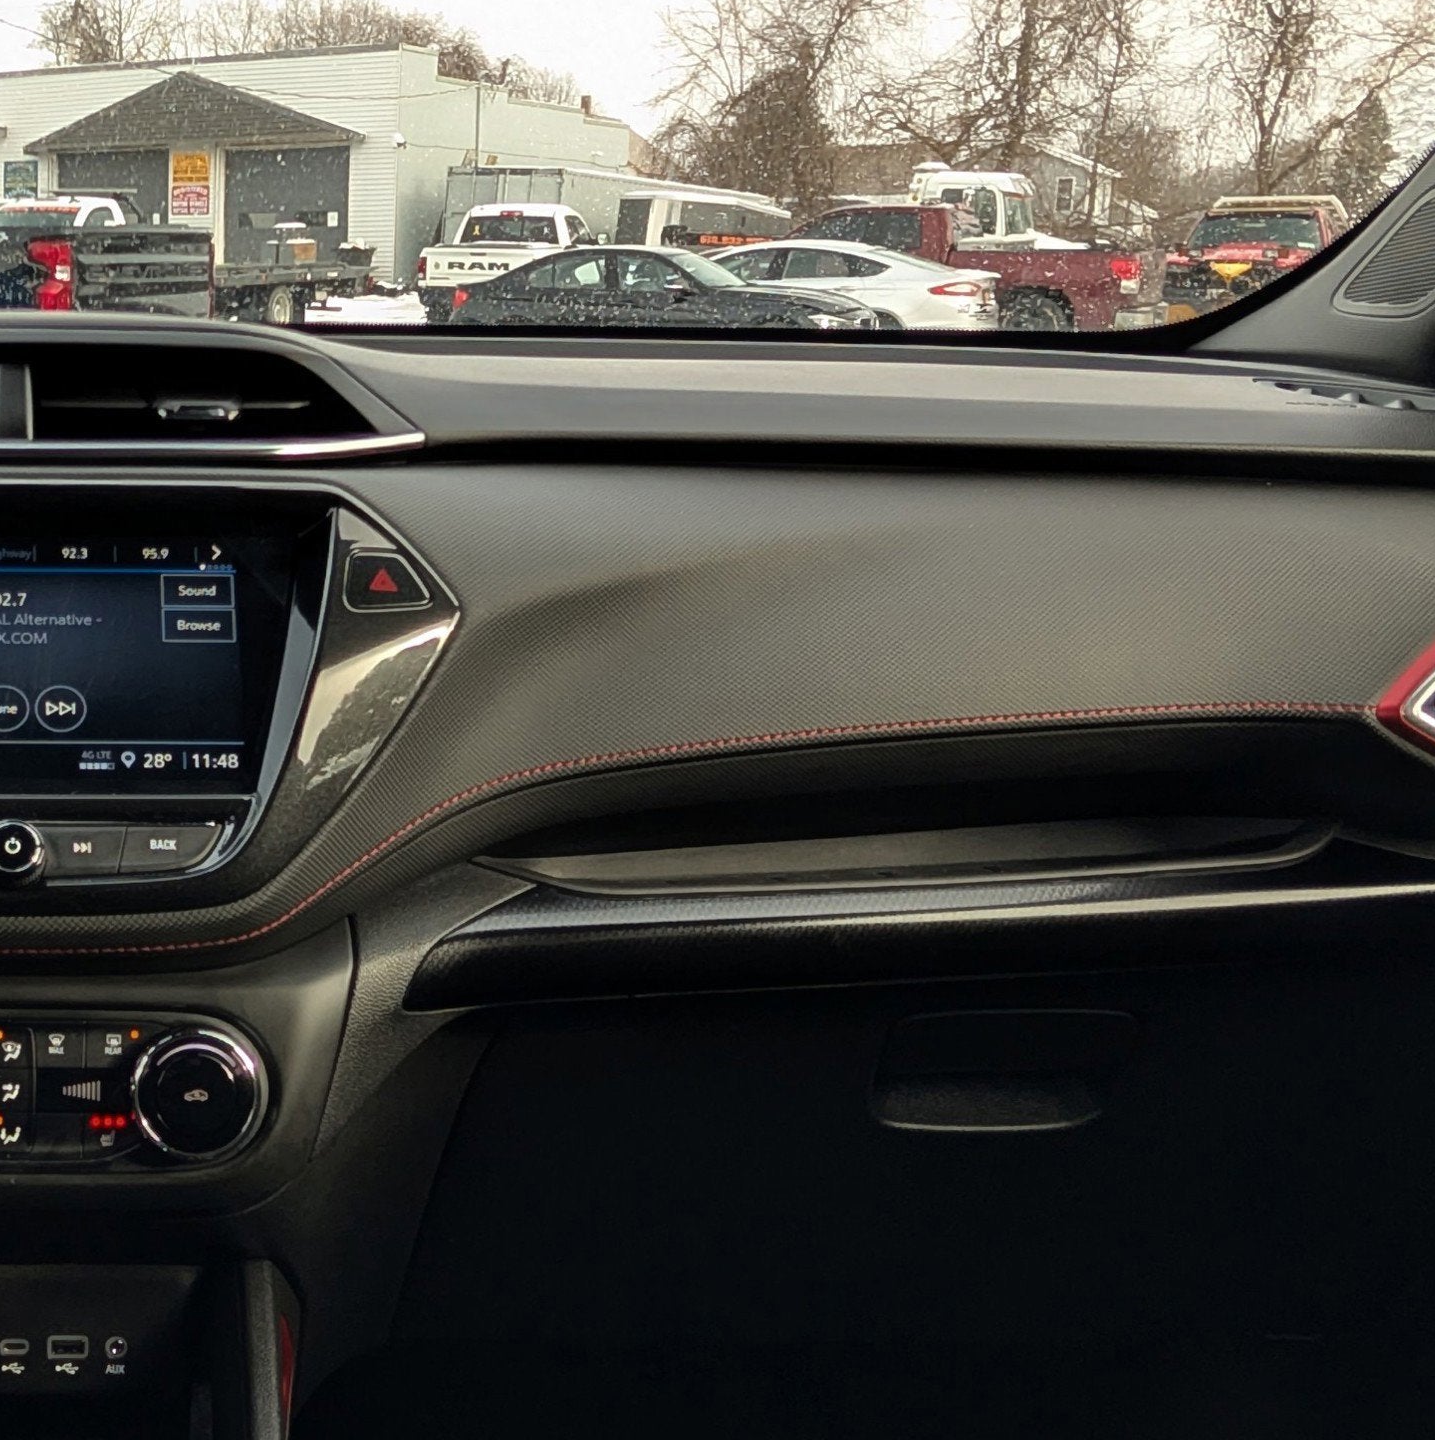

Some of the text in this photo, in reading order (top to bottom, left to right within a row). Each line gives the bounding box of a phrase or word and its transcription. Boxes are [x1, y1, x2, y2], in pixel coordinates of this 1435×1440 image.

[447, 261, 510, 271] RAM
[61, 547, 88, 560] 92.3
[142, 547, 169, 560] 95.9
[178, 584, 217, 598] Sound
[14, 612, 92, 627] Alternative
[176, 619, 221, 632] Browse
[81, 751, 112, 760] 4G LTE
[143, 753, 173, 769] 28°
[192, 752, 239, 769] 11:48
[149, 839, 177, 851] BACK
[104, 1046, 122, 1055] REAR
